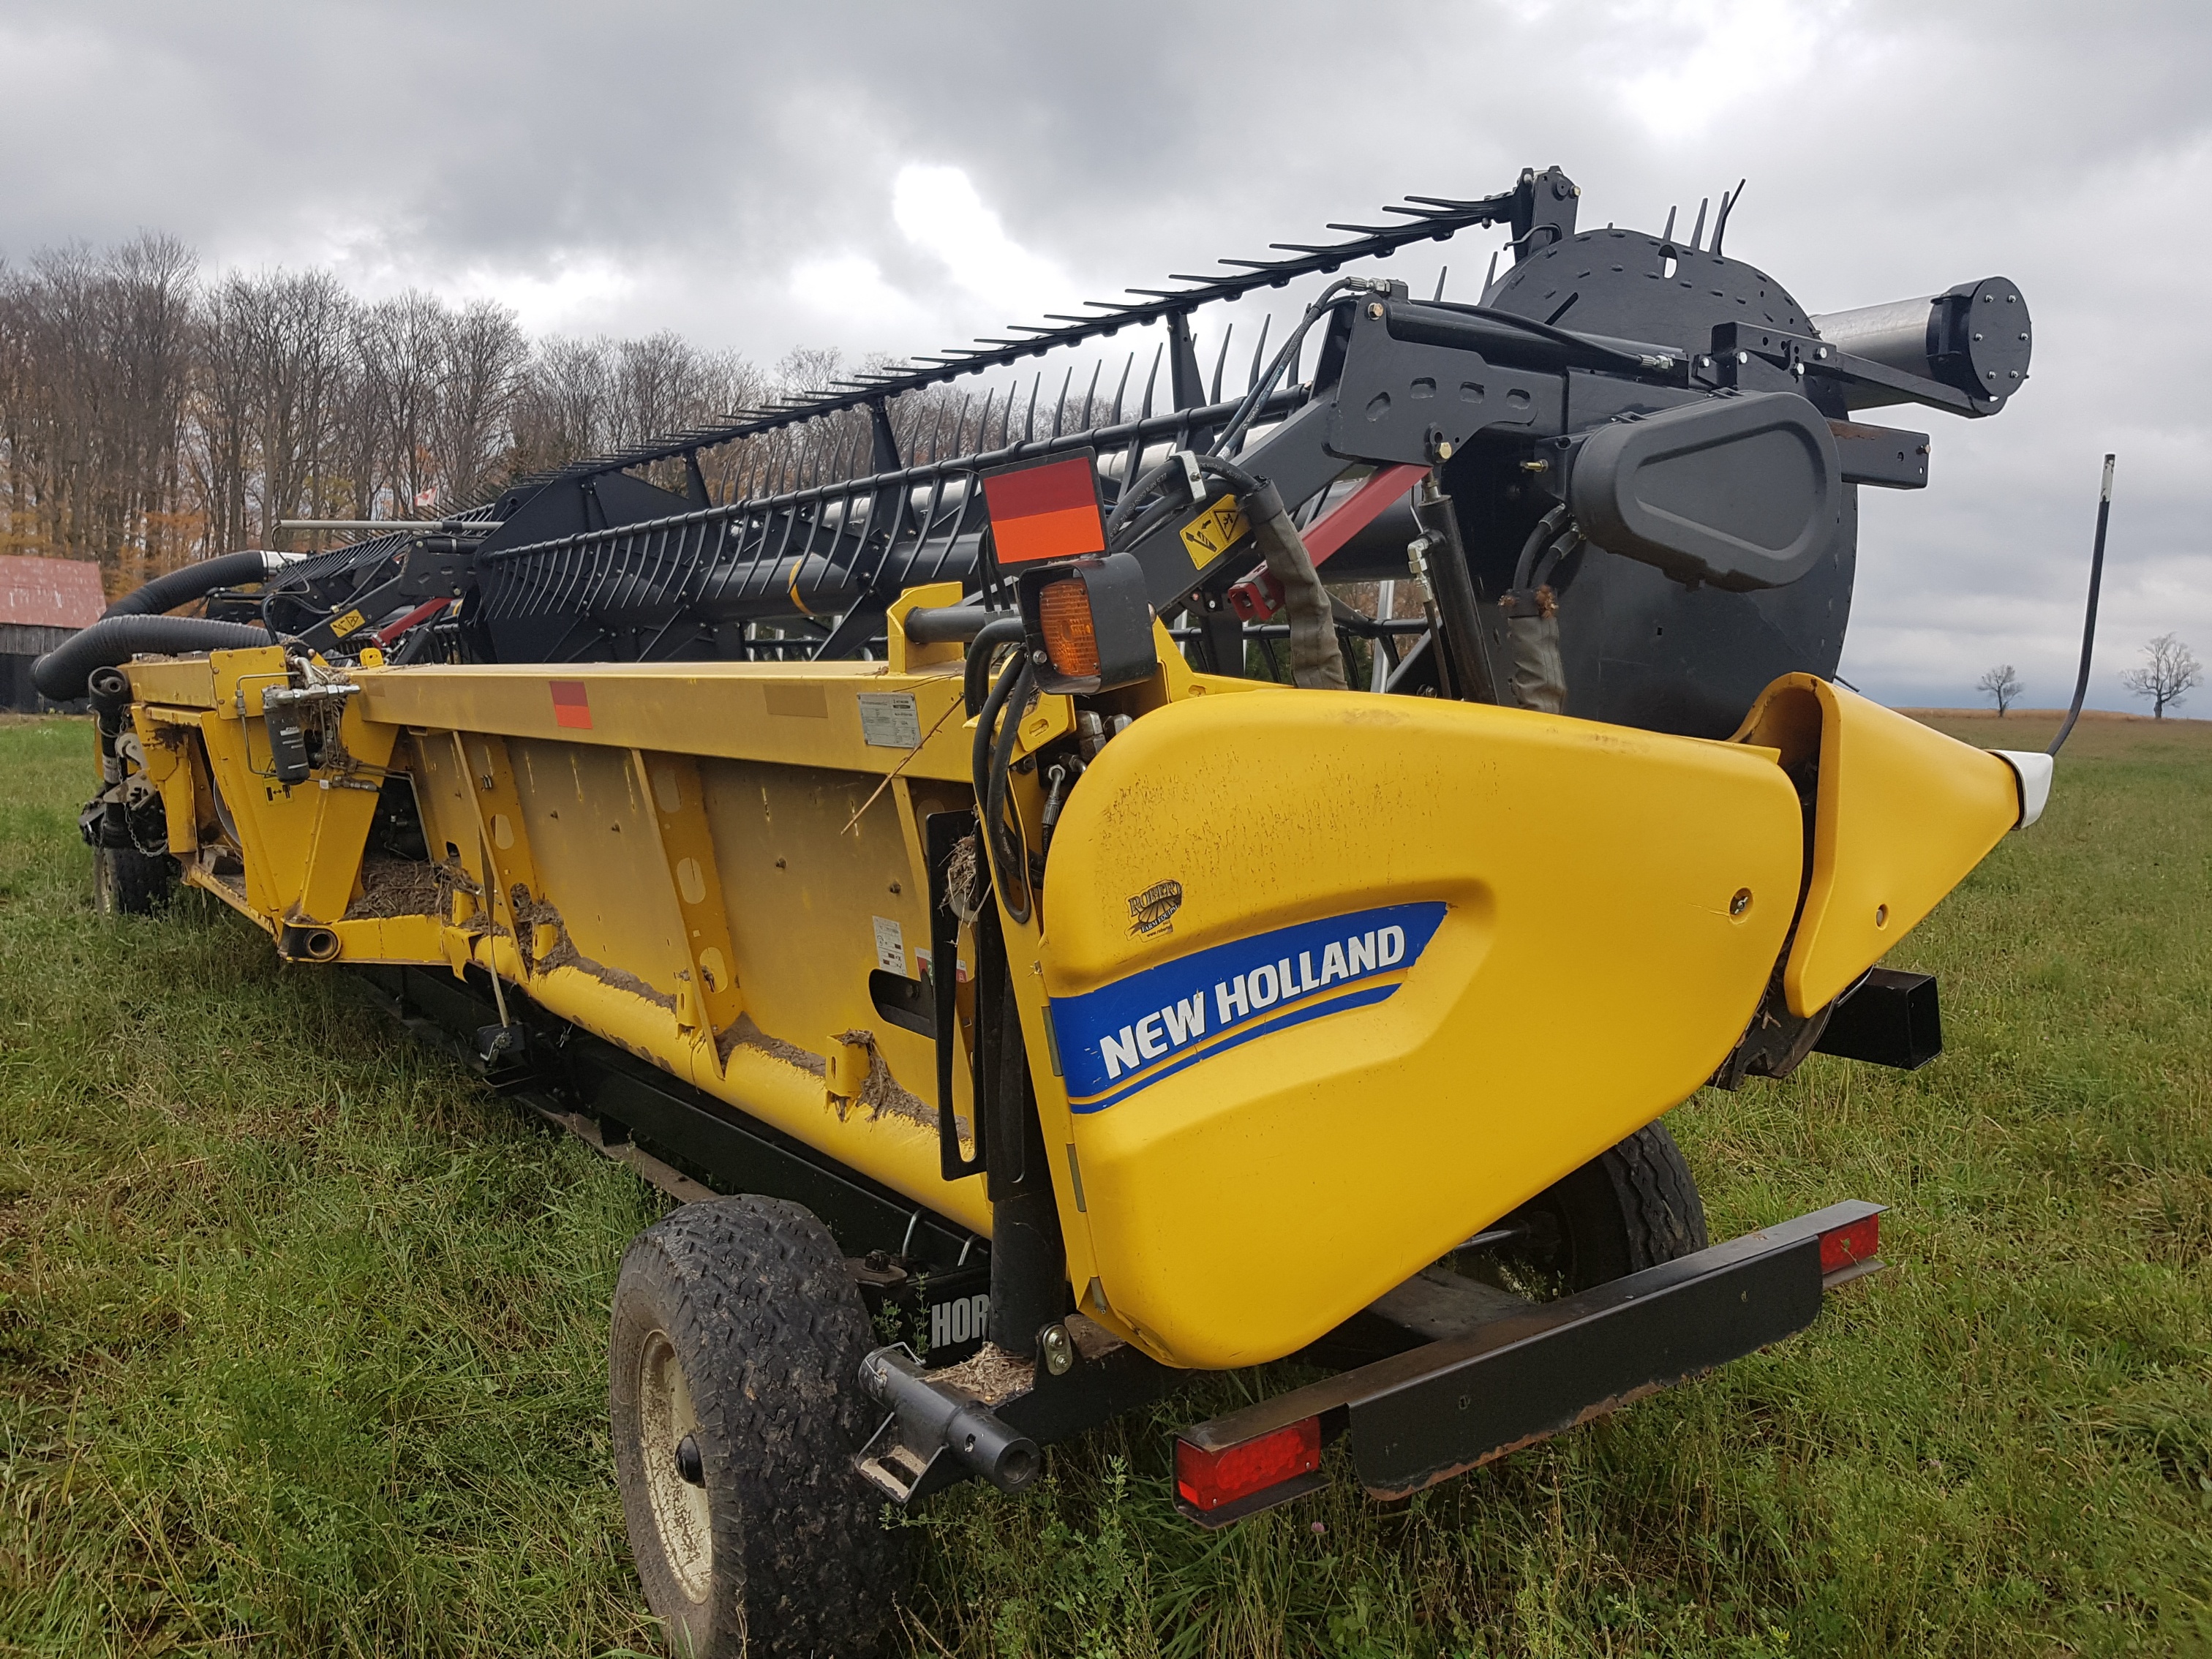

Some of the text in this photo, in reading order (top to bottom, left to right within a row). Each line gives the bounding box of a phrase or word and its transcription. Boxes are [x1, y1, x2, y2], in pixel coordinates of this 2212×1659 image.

[1142, 920, 1159, 933] FARM
[1099, 925, 1405, 1080] NEW HOLLAND
[932, 1293, 990, 1349] HOR
